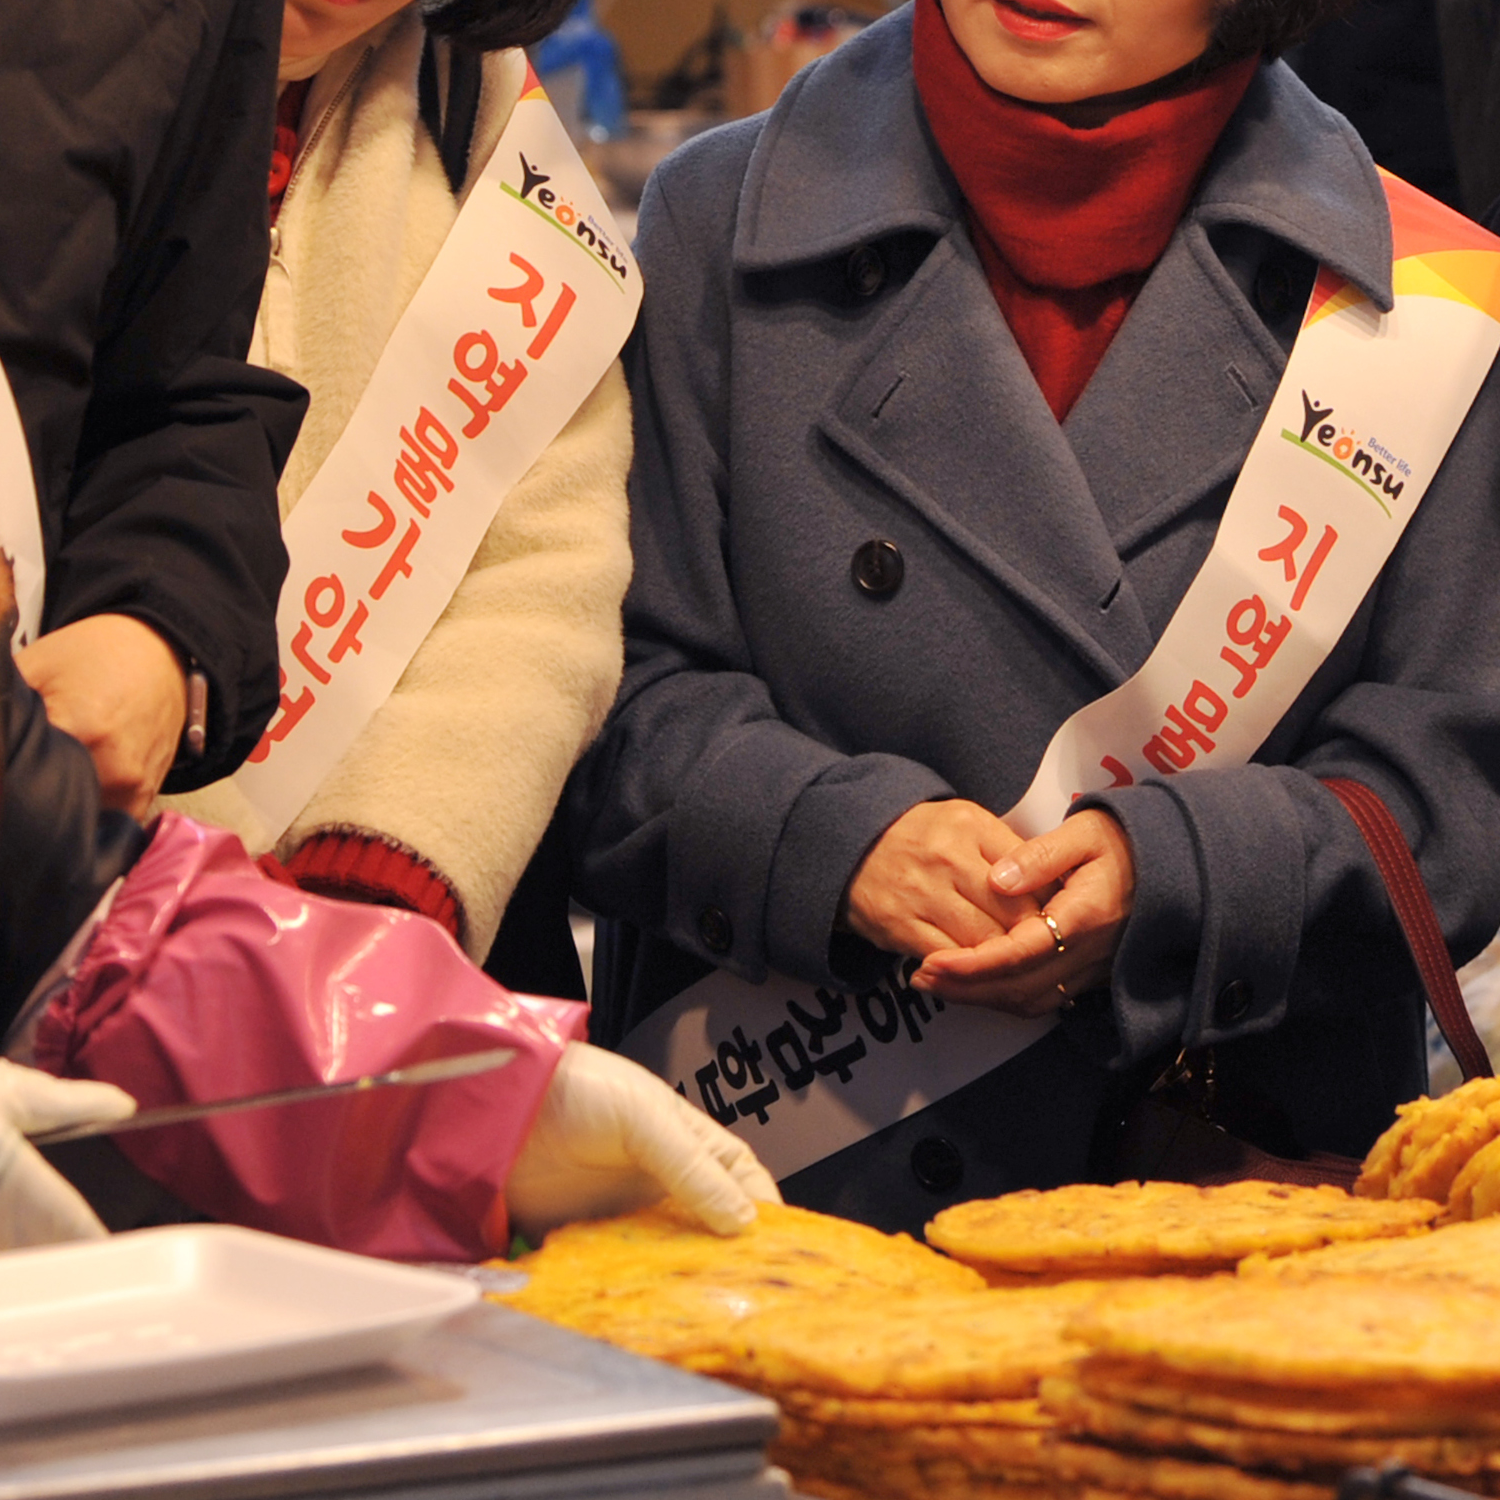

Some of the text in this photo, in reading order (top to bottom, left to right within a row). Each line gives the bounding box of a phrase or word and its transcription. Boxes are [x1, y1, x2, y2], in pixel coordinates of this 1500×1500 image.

[518, 151, 628, 280] Yeonsu
[1300, 389, 1406, 501] Yeonsu
[1367, 437, 1412, 477] Better life
